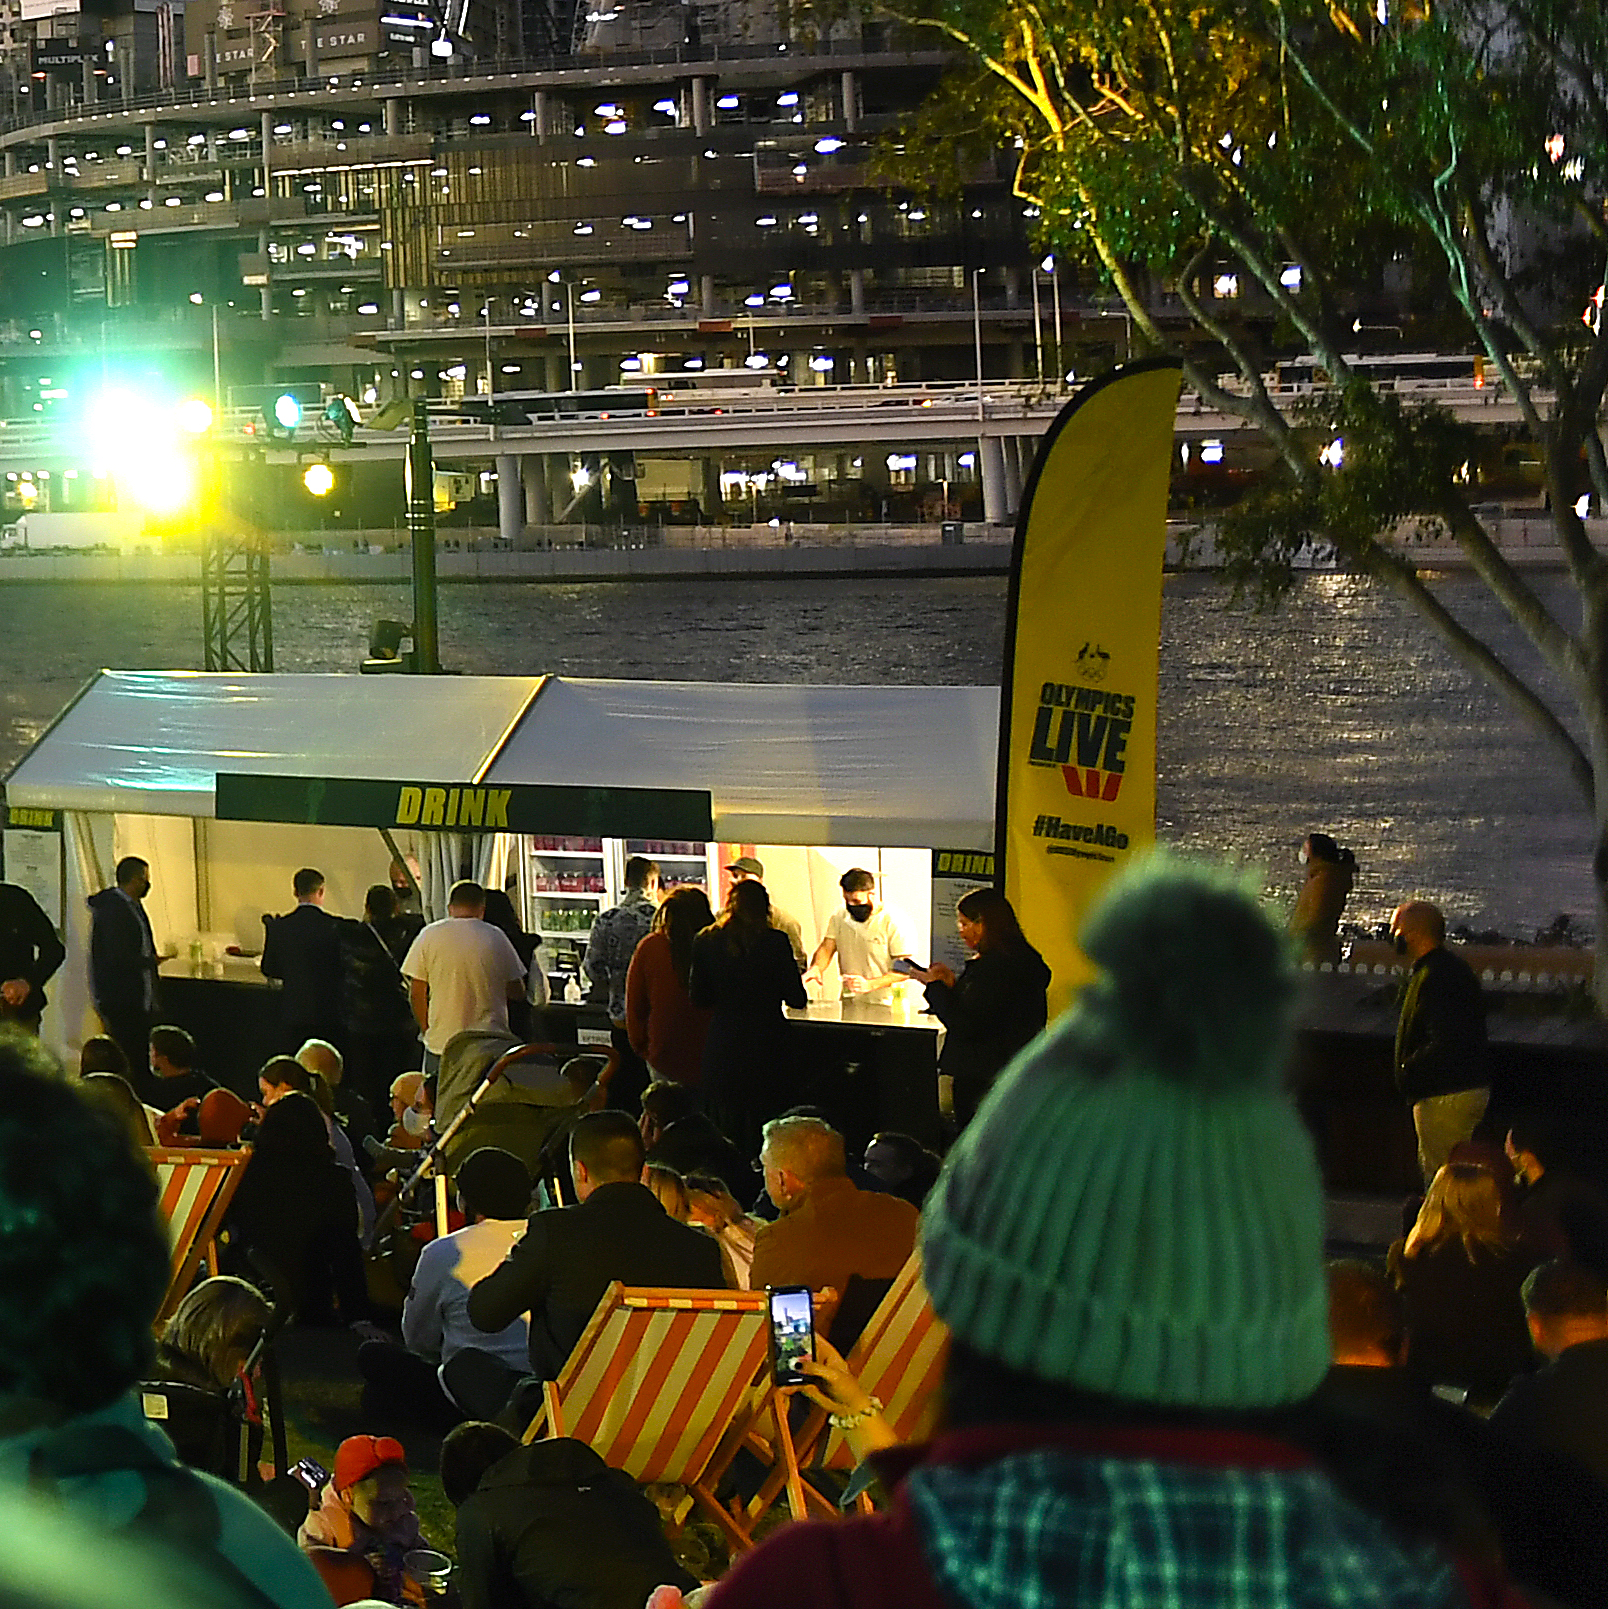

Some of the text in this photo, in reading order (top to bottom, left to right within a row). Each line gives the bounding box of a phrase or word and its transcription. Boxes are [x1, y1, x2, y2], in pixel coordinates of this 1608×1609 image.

[225, 48, 254, 62] STAR
[300, 33, 365, 49] TE STAR
[1039, 681, 1136, 719] OLYMPICS
[1029, 705, 1133, 774] LIVE
[396, 786, 512, 828] DRINK
[1032, 814, 1130, 850] #HaveAGo
